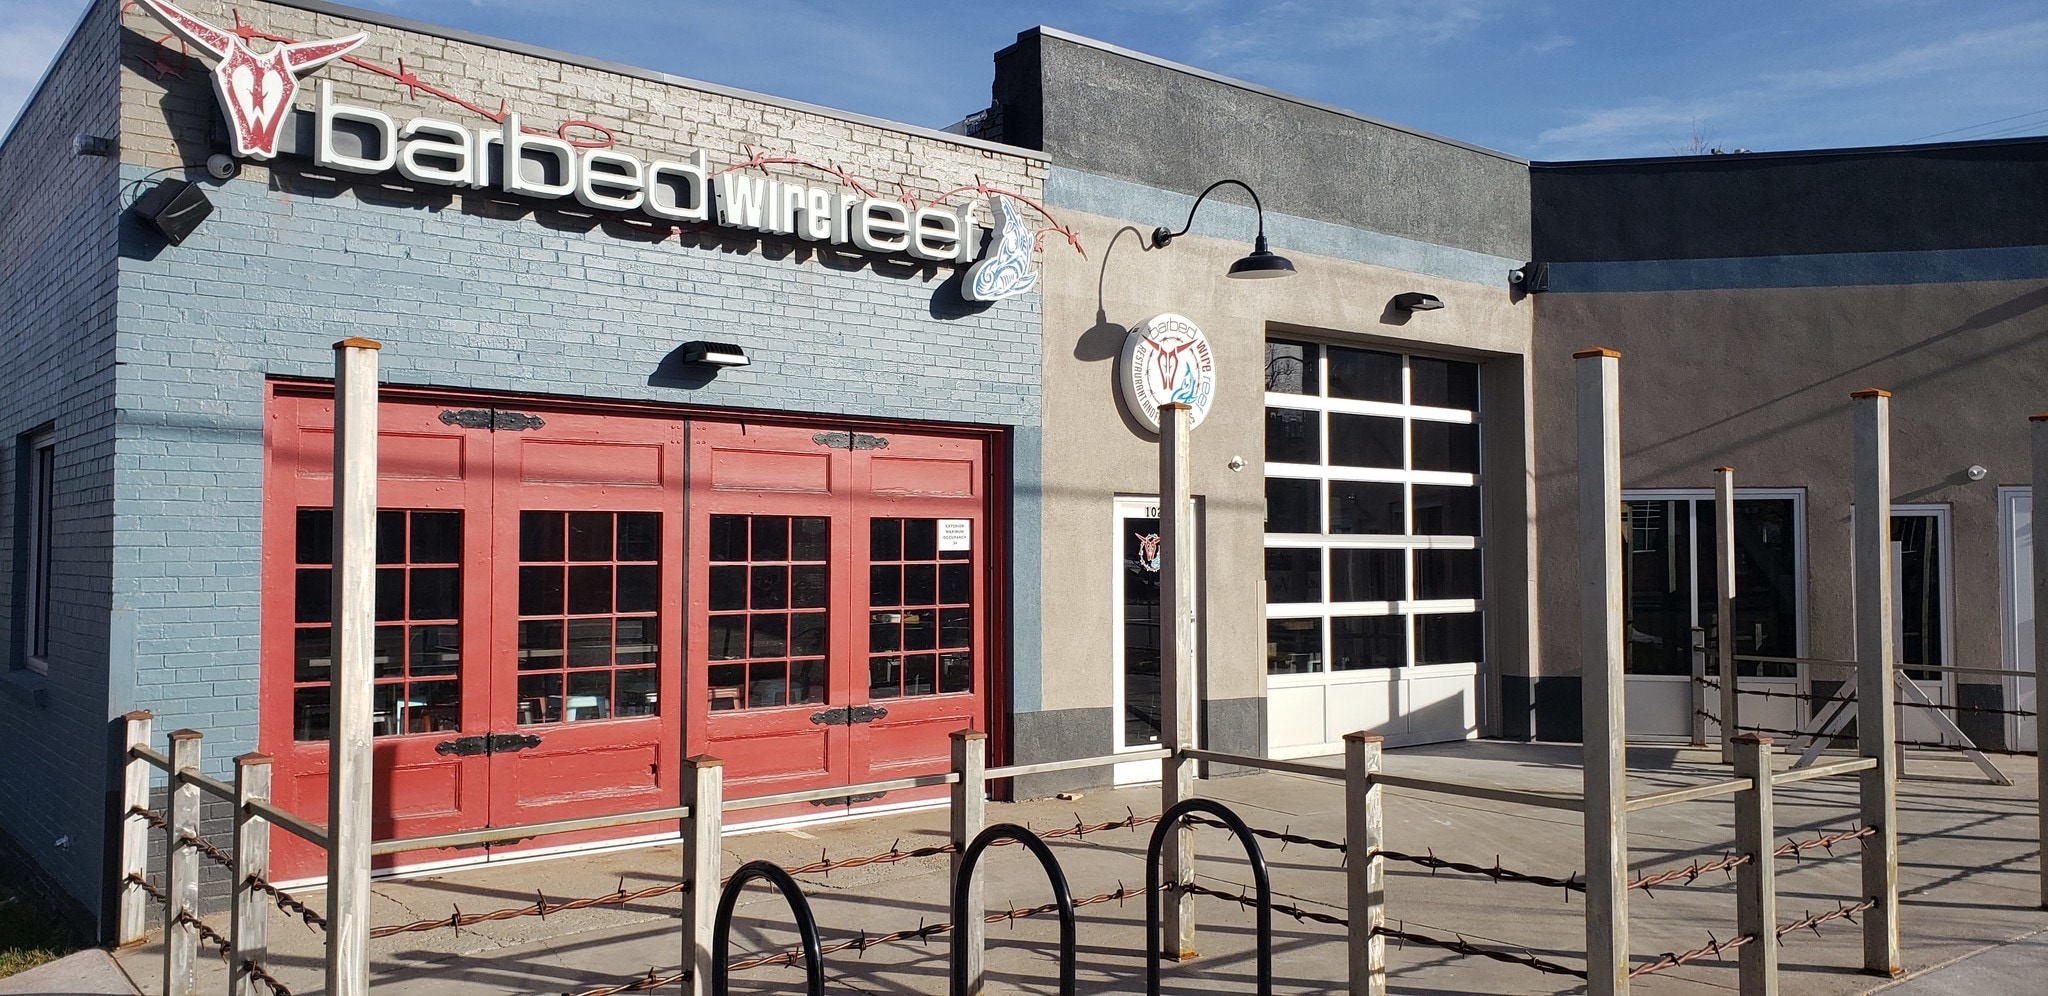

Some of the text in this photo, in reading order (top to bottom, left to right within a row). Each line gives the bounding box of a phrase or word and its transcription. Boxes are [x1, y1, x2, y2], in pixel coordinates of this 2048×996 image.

[316, 79, 979, 264] barbed wire reef
[1134, 344, 1147, 402] RESTAURANT
[1149, 317, 1212, 414] barbed wire reef
